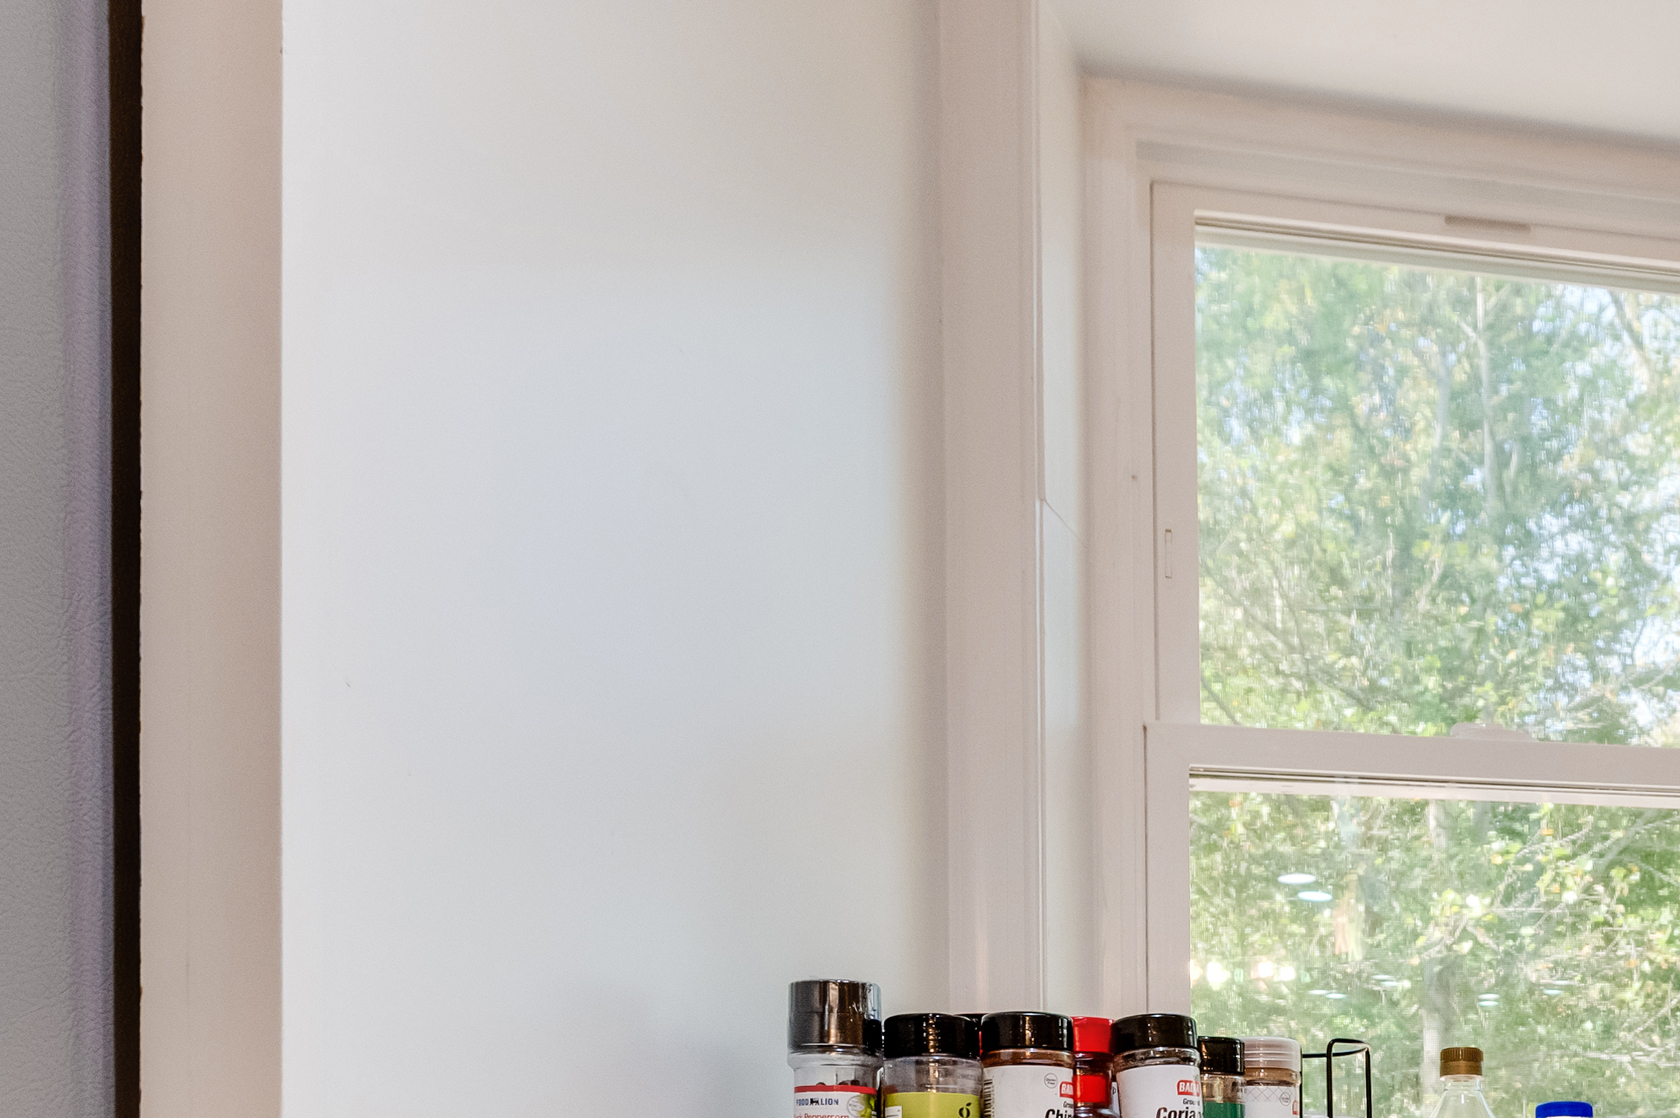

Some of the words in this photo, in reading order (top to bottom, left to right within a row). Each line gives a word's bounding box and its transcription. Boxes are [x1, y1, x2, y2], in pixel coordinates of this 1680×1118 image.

[1061, 1083, 1074, 1096] BAD
[1179, 1082, 1200, 1093] BAD
[820, 1098, 839, 1106] LION
